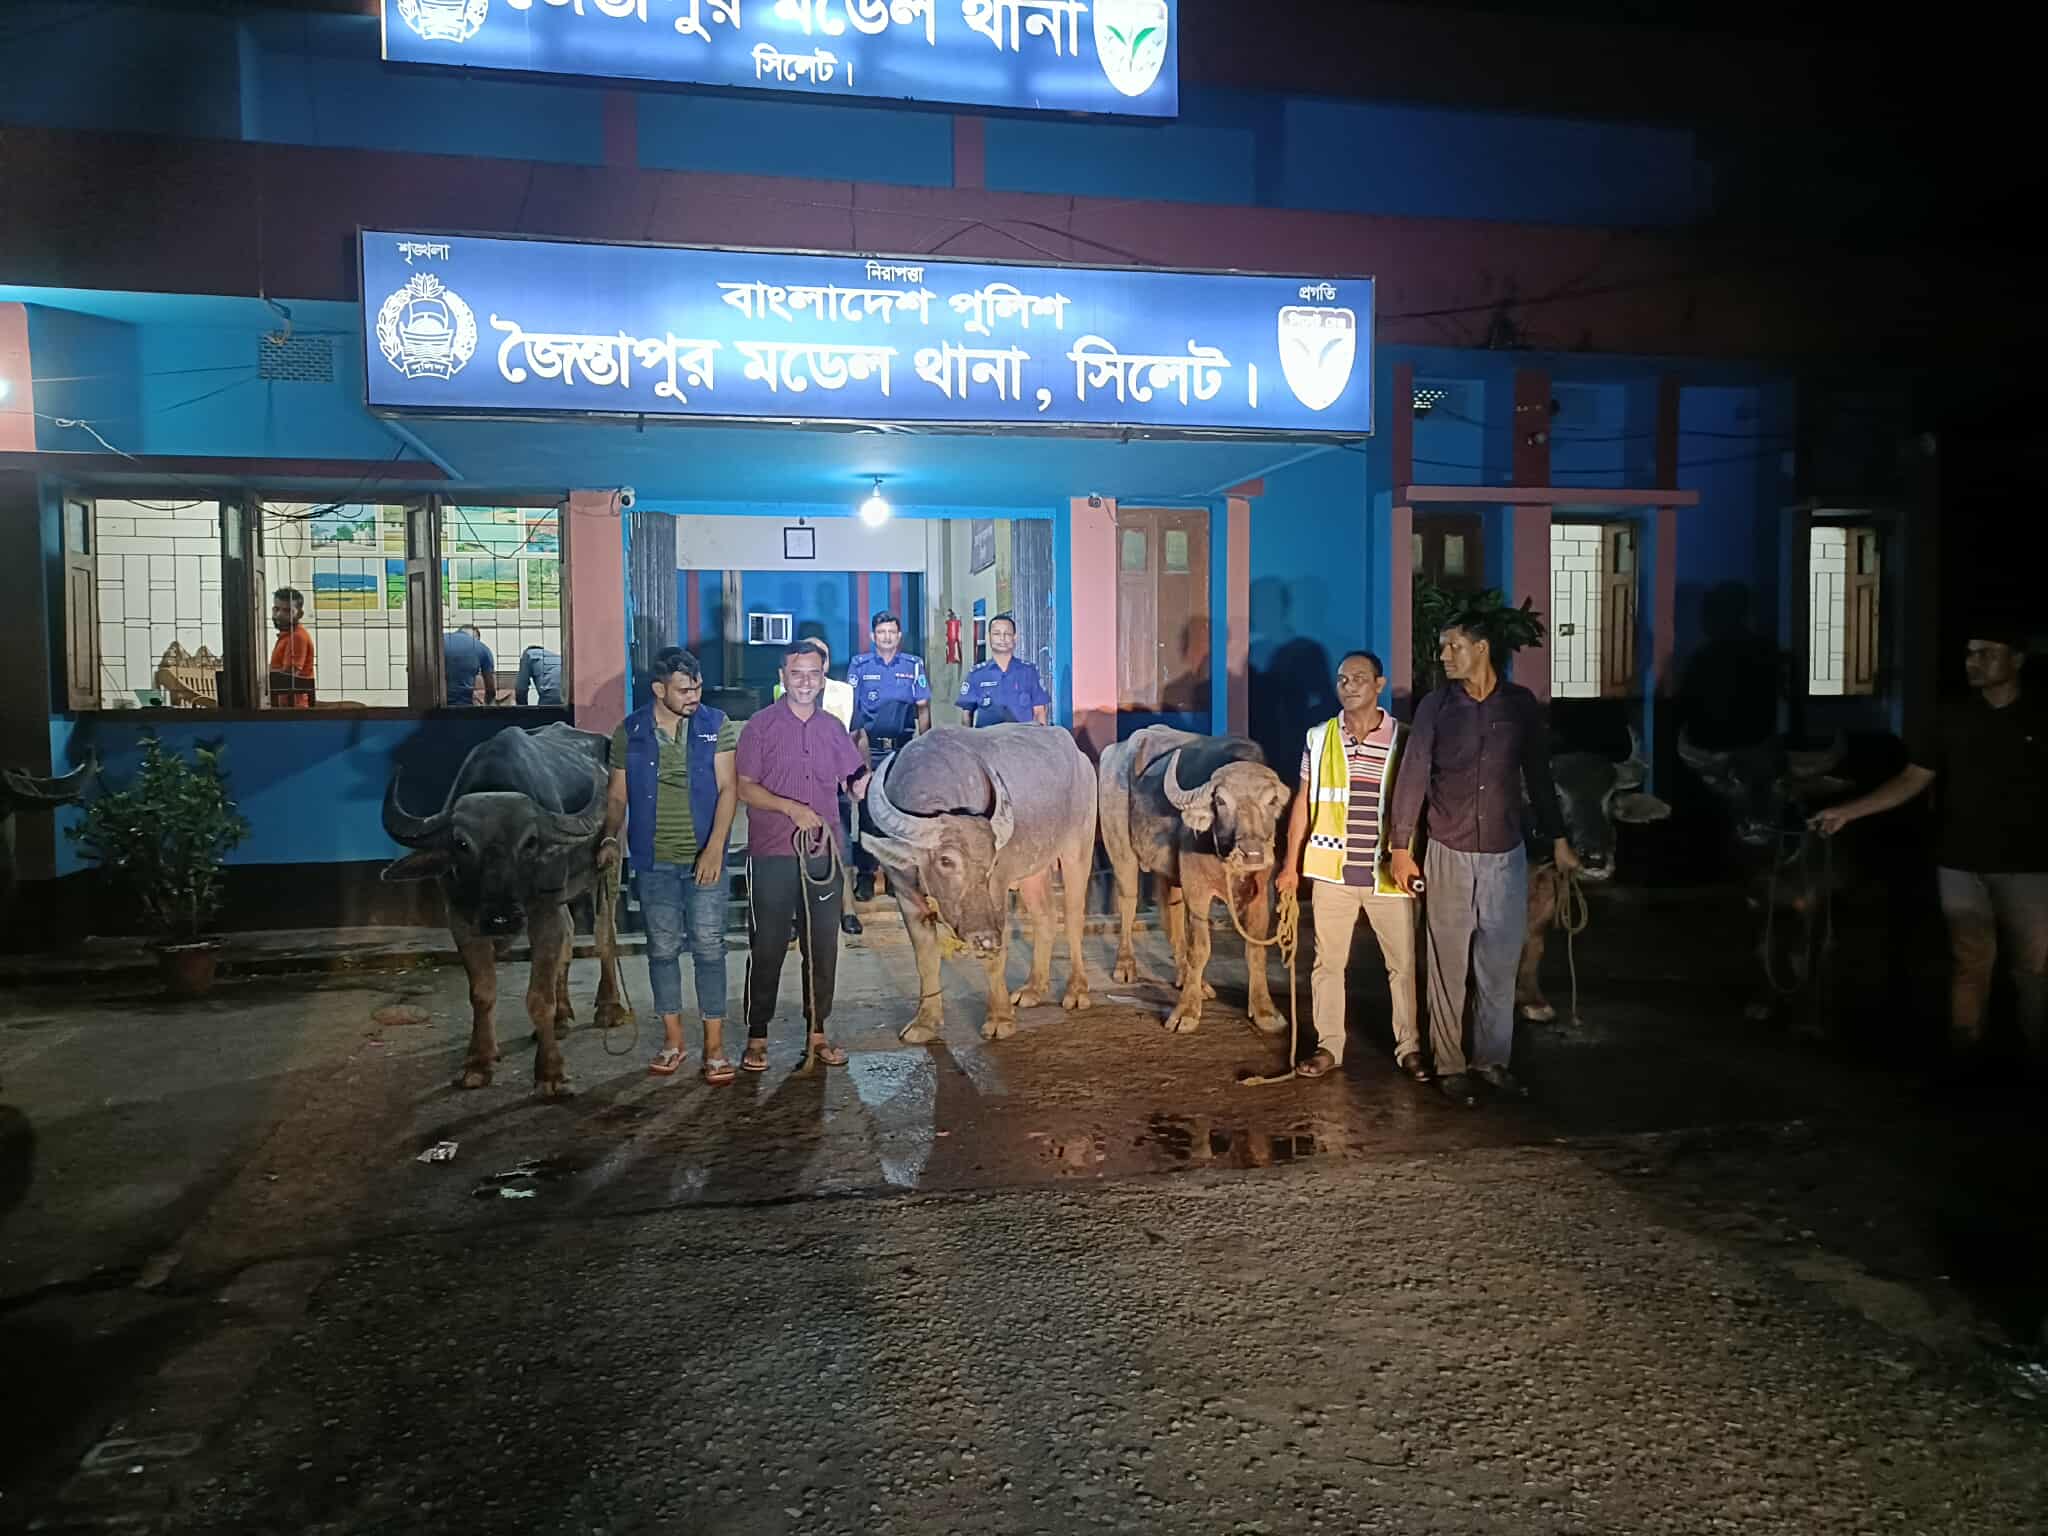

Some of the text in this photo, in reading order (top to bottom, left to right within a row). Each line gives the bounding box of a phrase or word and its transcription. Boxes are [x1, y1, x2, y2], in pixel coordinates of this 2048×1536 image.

[961, 0, 1088, 57] থানা
[751, 43, 838, 84] সিলেট
[864, 260, 924, 283] নিরাপত্তা
[1299, 282, 1337, 301] প্রগতি
[717, 281, 1071, 336] বাংলাদেশ পুলিশ
[490, 313, 722, 403] জৈন্তাপুর
[733, 341, 898, 396] মডেল
